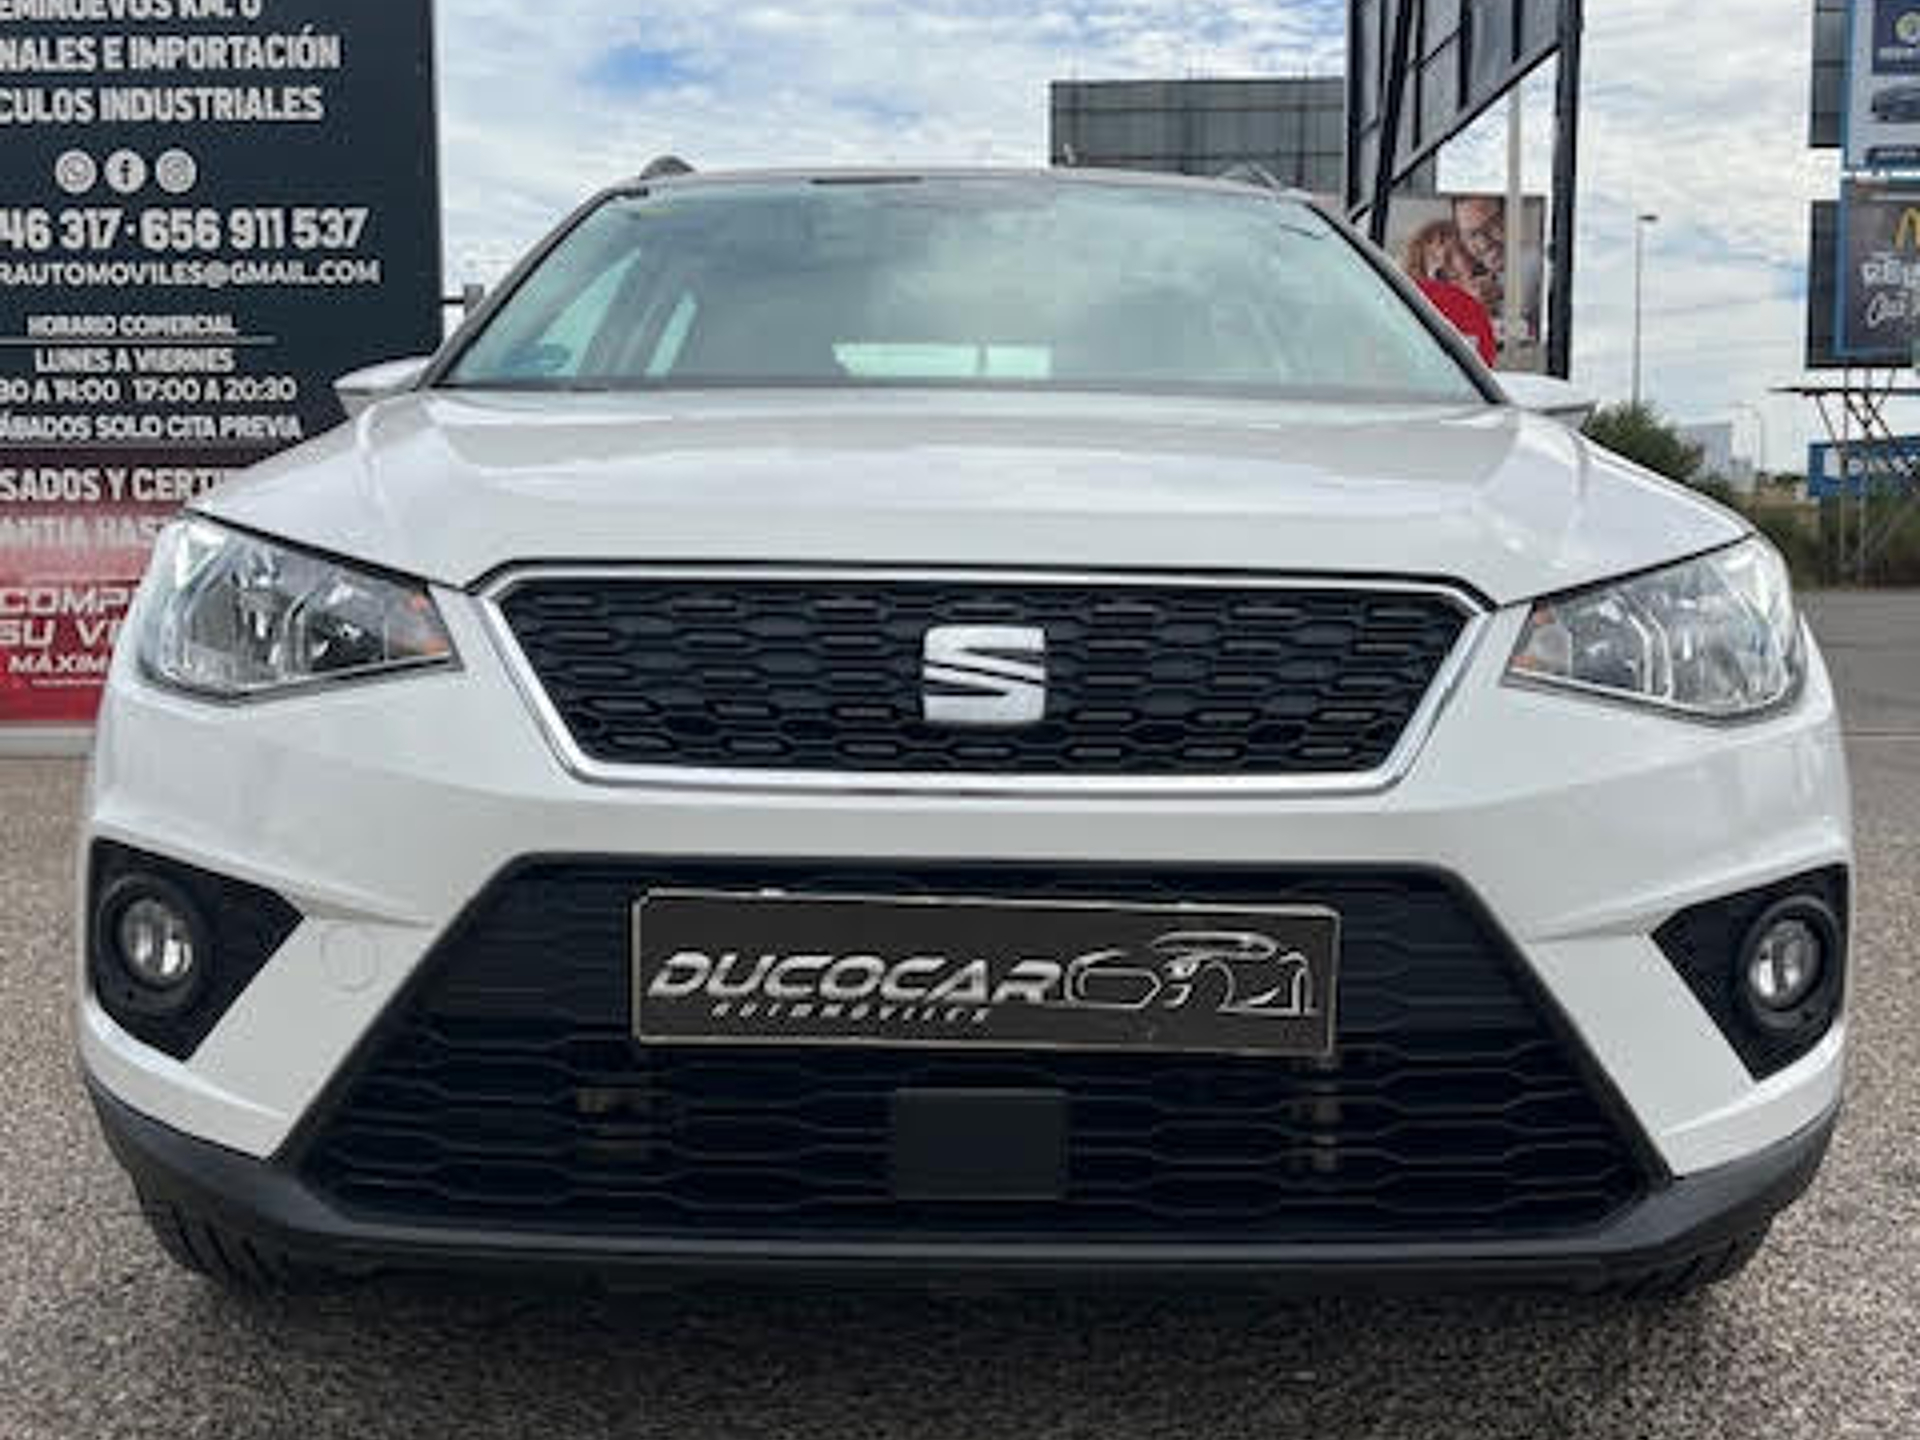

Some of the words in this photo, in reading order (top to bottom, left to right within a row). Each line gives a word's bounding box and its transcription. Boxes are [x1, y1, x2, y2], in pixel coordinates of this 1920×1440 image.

[103, 36, 123, 70] E
[130, 25, 341, 70] IMPORTACIÓN
[101, 87, 324, 121] INDUSTRIALES
[0, 207, 50, 250] 46
[229, 207, 285, 248] 911
[292, 207, 369, 249] 537
[27, 315, 117, 336] HORARIO
[119, 315, 238, 337] COMERCIAL
[35, 348, 111, 372] LUNES
[115, 349, 132, 372] A
[134, 348, 235, 373] VIERNES
[32, 380, 49, 402] A
[204, 379, 221, 401] A
[224, 377, 297, 401] 20:30
[97, 415, 161, 438] SOLO
[167, 415, 217, 438] CITA
[220, 414, 301, 438] PREVIA
[104, 467, 128, 500] Y
[648, 952, 1061, 1004] DUCOCAR
